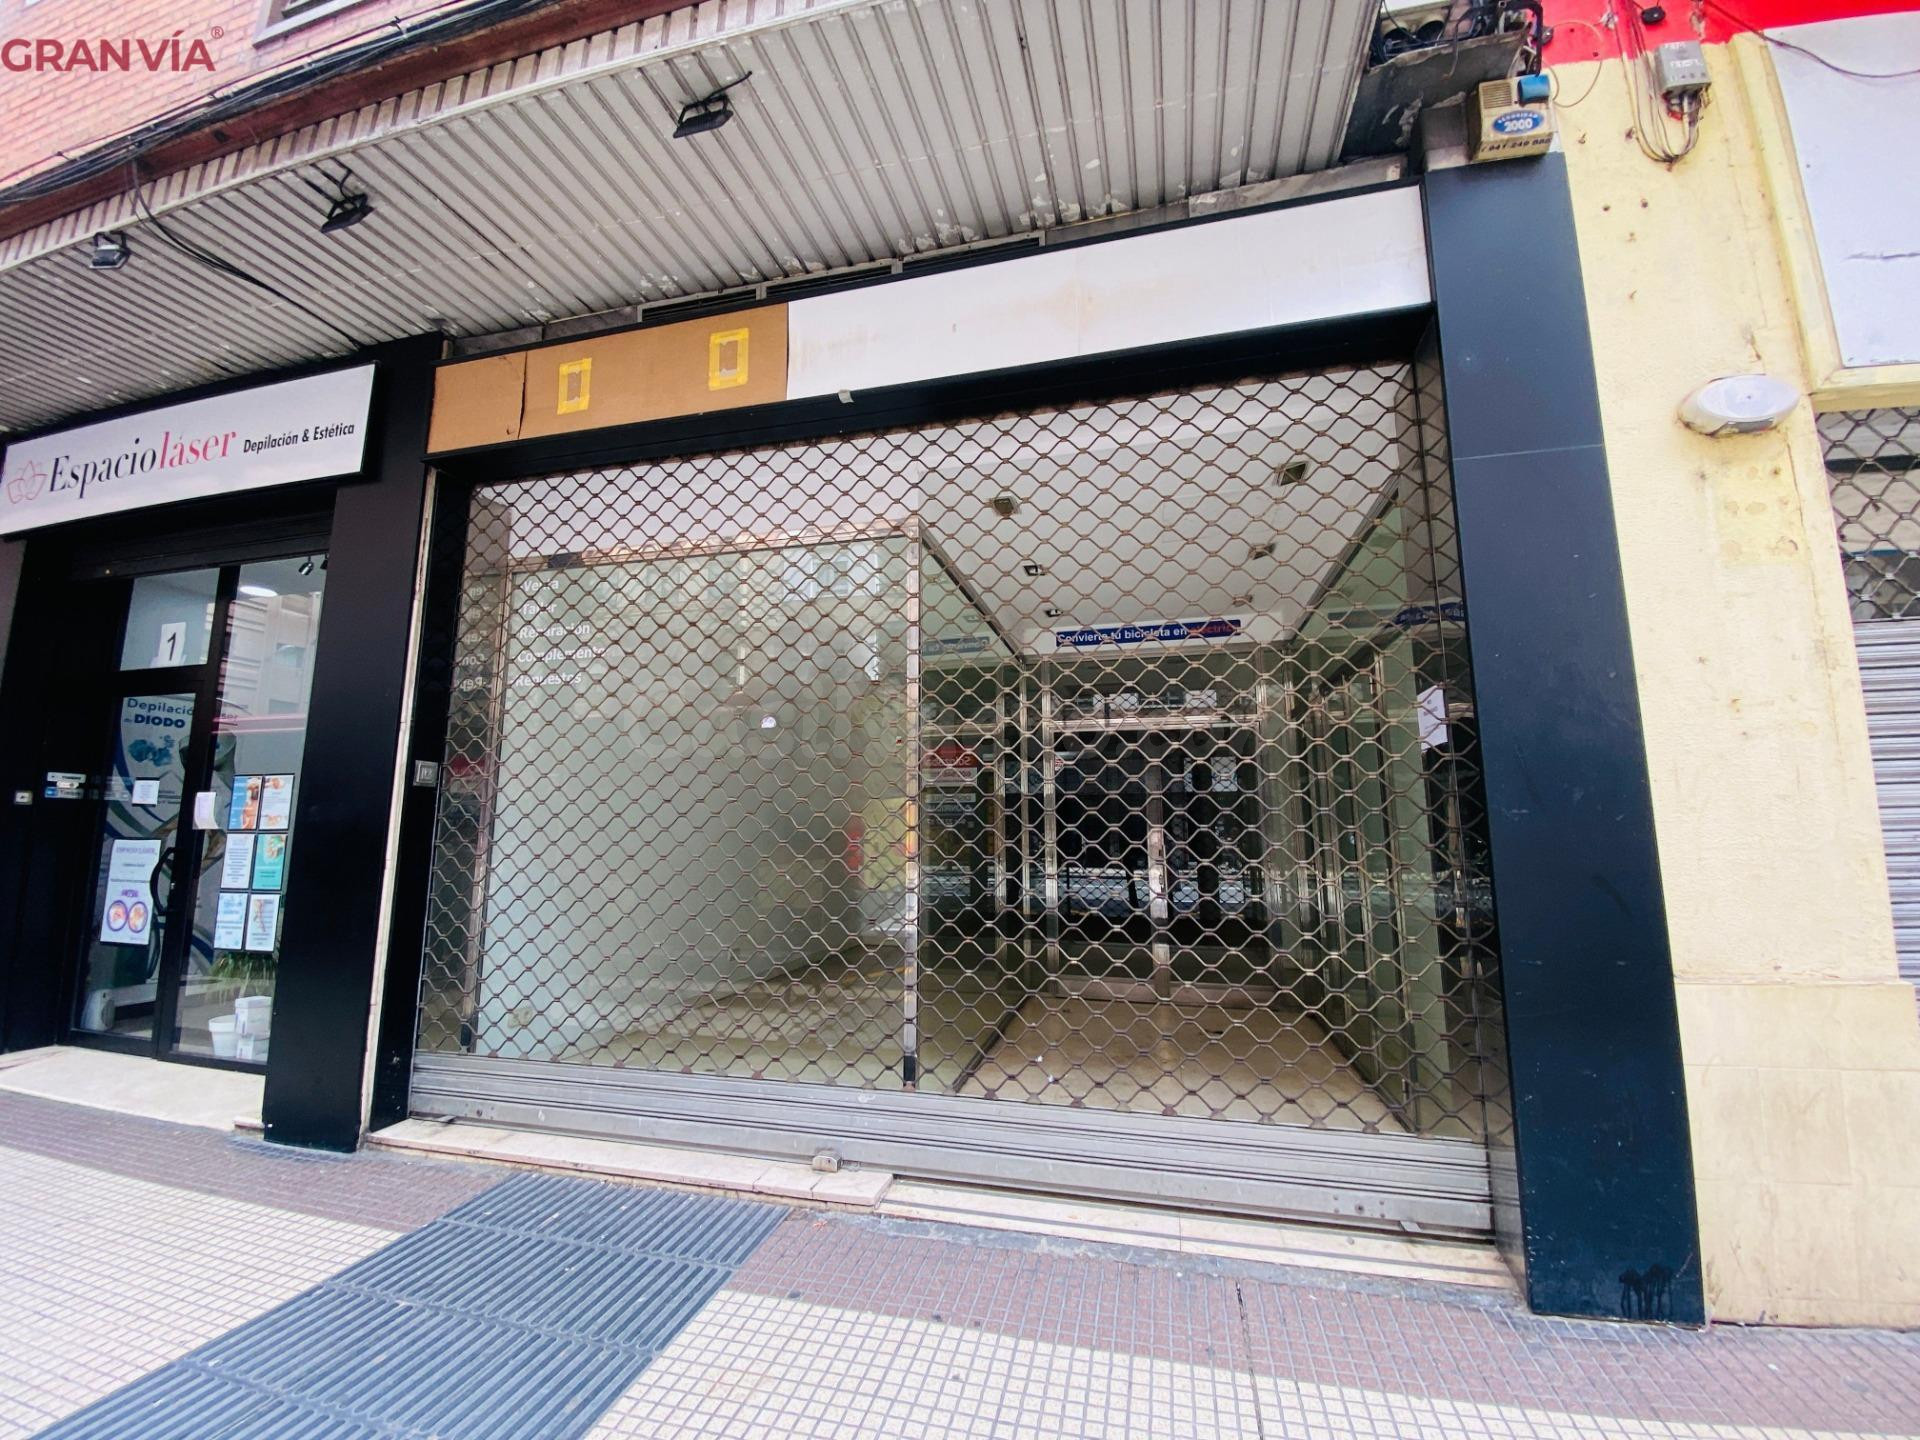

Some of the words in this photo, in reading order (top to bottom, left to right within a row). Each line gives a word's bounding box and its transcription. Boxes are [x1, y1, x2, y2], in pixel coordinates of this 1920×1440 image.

[1504, 118, 1533, 132] 2000
[243, 431, 299, 455] Depilación
[302, 428, 310, 443] &
[313, 422, 355, 441] Estética
[523, 579, 560, 592] Vea
[519, 622, 590, 640] Rearaión
[1057, 631, 1108, 643] Convierte
[1124, 628, 1170, 639] bicicleta
[1173, 627, 1187, 637] en
[167, 631, 177, 662] 1
[134, 713, 186, 728] DIODO
